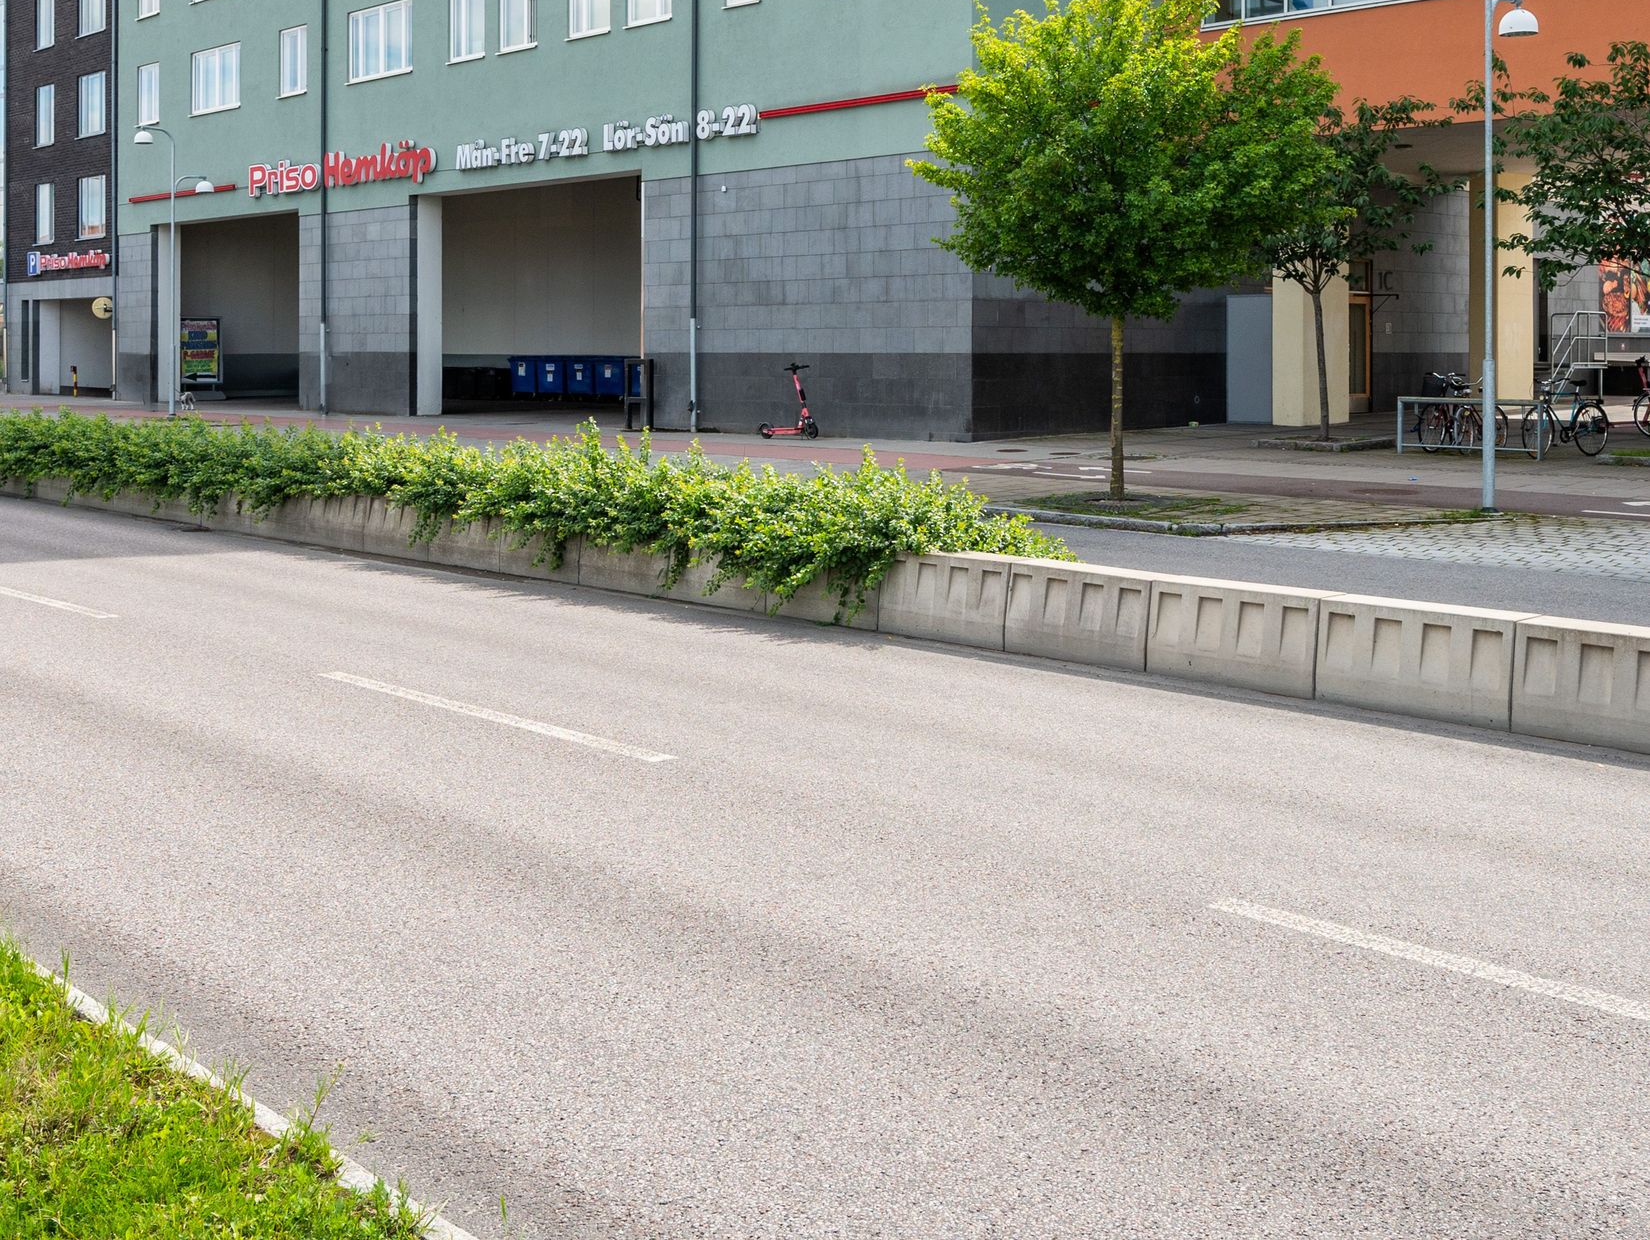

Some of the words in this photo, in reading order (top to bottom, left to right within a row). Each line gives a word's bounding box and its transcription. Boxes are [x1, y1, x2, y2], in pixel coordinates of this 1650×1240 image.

[249, 160, 321, 197] Priso
[324, 140, 436, 189] Hemköp
[456, 139, 535, 170] Mån-Fre
[603, 113, 690, 151] Lör-Sön
